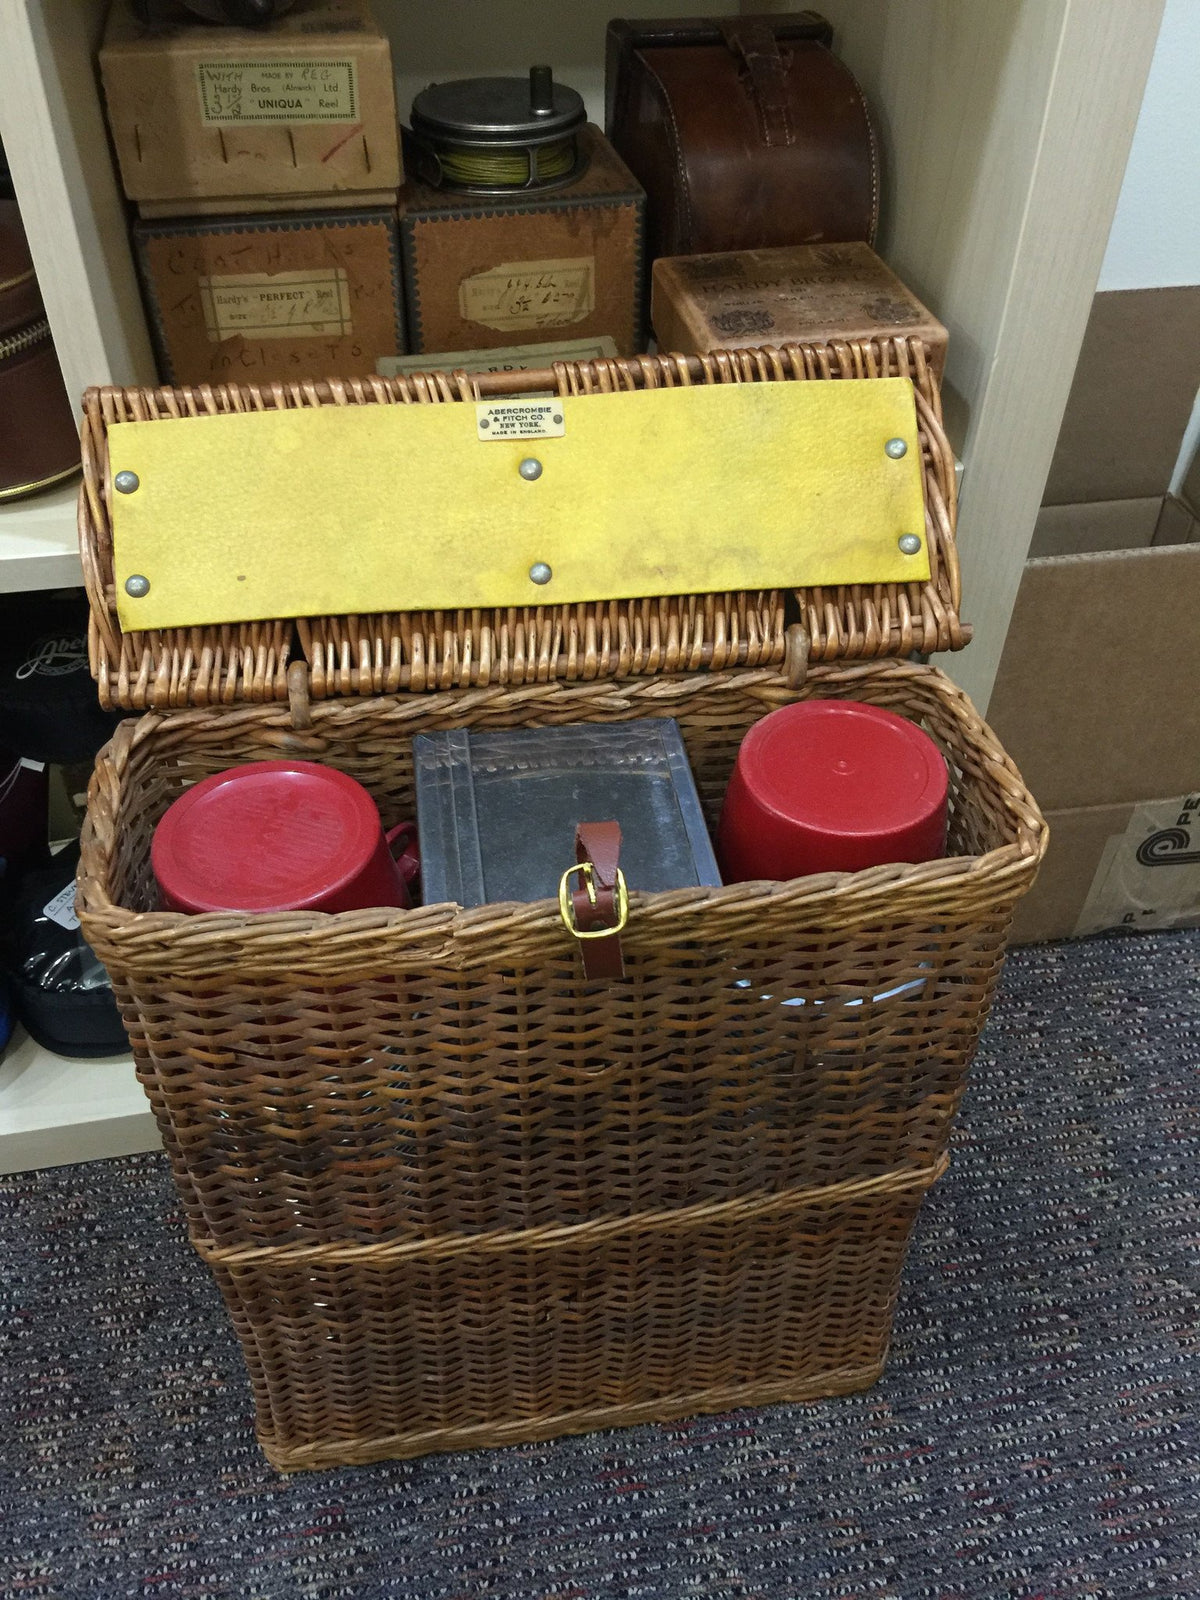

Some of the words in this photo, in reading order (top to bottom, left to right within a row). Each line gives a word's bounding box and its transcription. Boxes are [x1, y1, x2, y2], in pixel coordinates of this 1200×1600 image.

[214, 84, 242, 96] Hardy
[251, 83, 271, 93] Bros
[323, 83, 339, 93] Ltd
[319, 98, 339, 108] Reel
[260, 291, 305, 302] PERFECT
[488, 406, 552, 415] ABERCROMBIE
